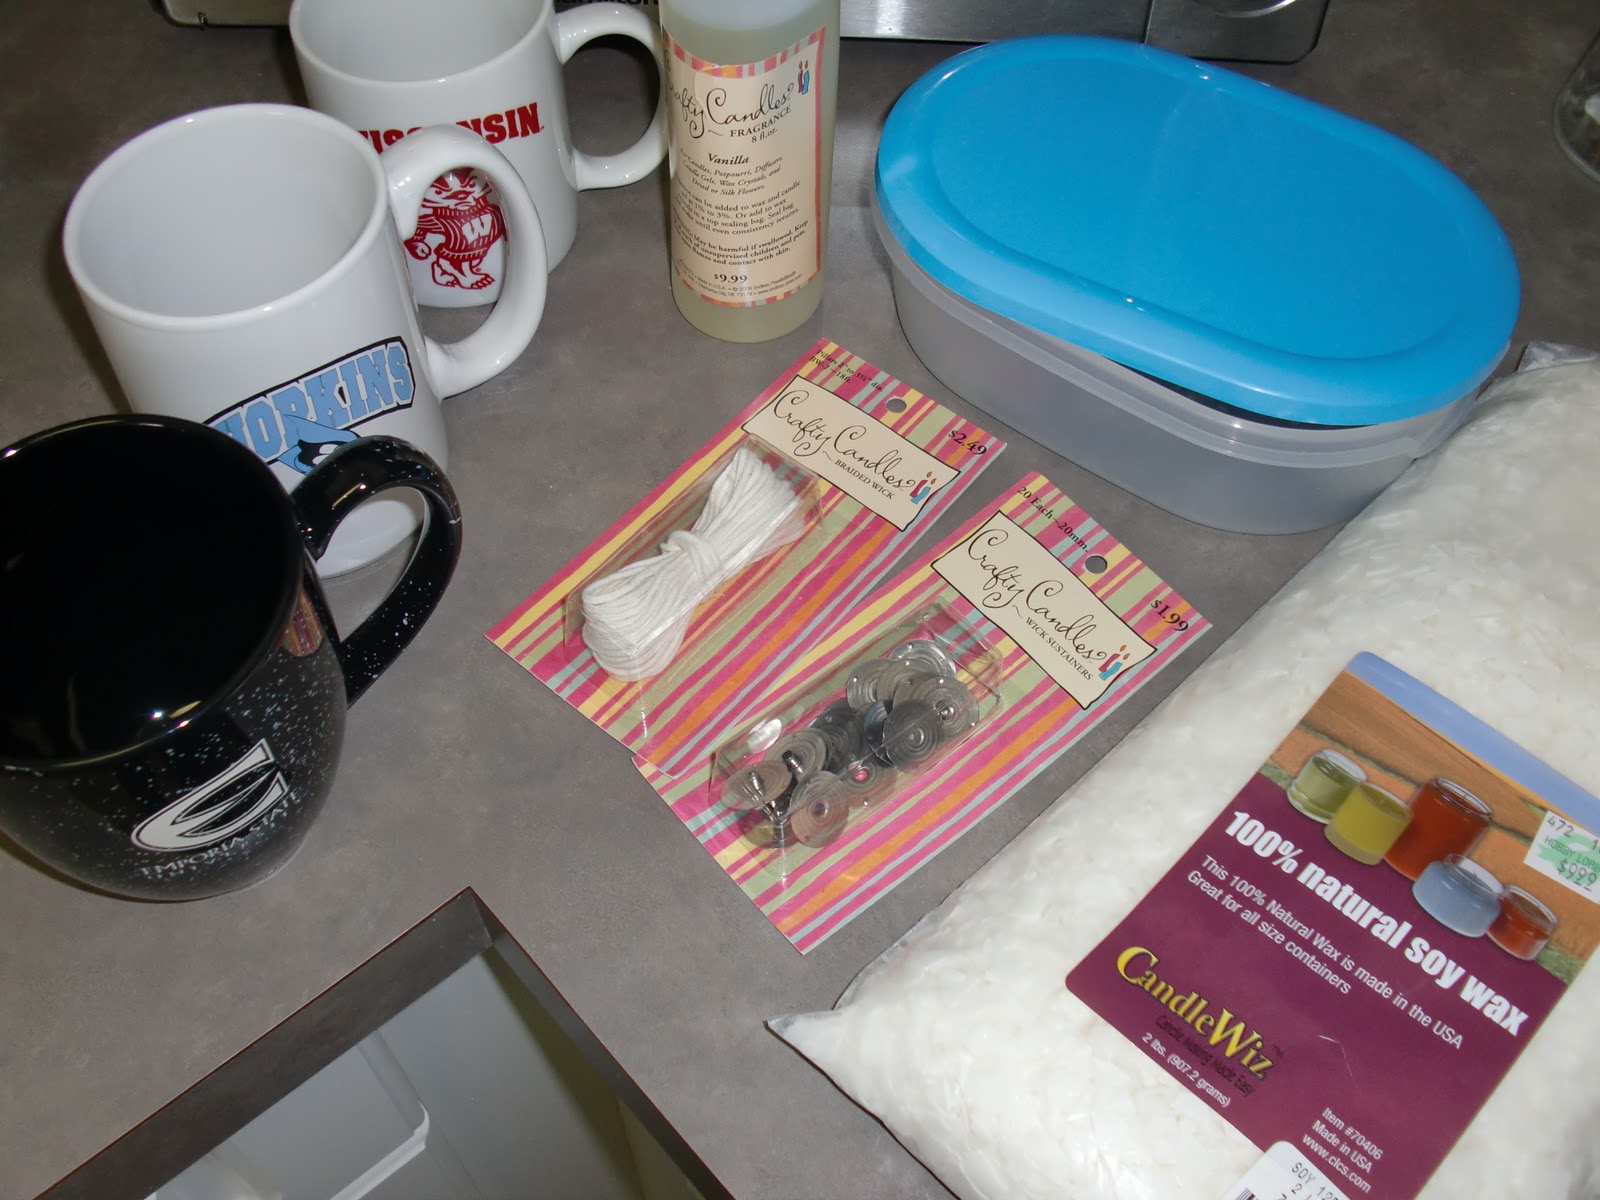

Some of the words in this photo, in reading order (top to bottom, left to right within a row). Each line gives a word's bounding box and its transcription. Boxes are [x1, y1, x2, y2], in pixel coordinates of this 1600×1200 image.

[730, 106, 792, 138] FRAGRANCE
[707, 152, 750, 166] Vanilla
[719, 179, 737, 187] Wax
[720, 188, 736, 196] Silk
[703, 199, 713, 209] be
[714, 203, 739, 212] added
[751, 199, 766, 209] wax
[767, 191, 780, 204] and
[735, 212, 748, 220] Or
[749, 207, 764, 218] add
[773, 198, 787, 208] wax
[461, 213, 492, 244] W
[706, 217, 719, 227] top
[720, 220, 749, 229] sealing
[767, 207, 782, 220] Seal
[782, 202, 795, 212] bag
[712, 227, 730, 235] even
[731, 220, 775, 236] consistency
[693, 233, 707, 247] May
[708, 242, 717, 250] be
[718, 244, 749, 253] harmful
[700, 246, 749, 259] unsupervised
[750, 245, 779, 258] children
[780, 236, 792, 247] and
[728, 258, 756, 266] contact
[757, 253, 774, 263] with
[713, 273, 748, 285] $9.99
[773, 389, 831, 457] Crafty
[833, 425, 916, 489] Candles
[949, 429, 988, 456] $2.49
[834, 458, 872, 485] BRAIDED
[871, 481, 896, 500] WICK
[1017, 486, 1031, 499] 20
[968, 528, 1025, 609] Crafty
[1026, 580, 1107, 661] Candles
[1151, 598, 1190, 633] $1.99
[1025, 616, 1049, 641] WICK
[1046, 636, 1094, 681] SUSTAINERS
[1547, 815, 1574, 838] 472
[1544, 835, 1576, 857] HOBBY
[1187, 869, 1223, 901] Great
[1221, 894, 1243, 913] for
[1240, 908, 1261, 926] all
[1257, 919, 1286, 945] size
[1284, 940, 1351, 994] containers
[1225, 811, 1303, 874] 100%
[1296, 862, 1413, 949] natural
[1404, 936, 1466, 989] soy
[1459, 974, 1529, 1037] wax
[1201, 854, 1229, 880] This
[1229, 875, 1267, 906] 100%
[1266, 899, 1315, 940] Natural
[1312, 933, 1342, 962] Wax
[1340, 954, 1355, 971] is
[1354, 967, 1393, 999] made
[1392, 992, 1408, 1010] in
[1408, 1003, 1432, 1027] the
[1432, 1020, 1464, 1050] USA
[1116, 946, 1274, 1080] CandleWiz
[1141, 1032, 1153, 1043] 2
[1150, 1038, 1167, 1058] lbs.
[1167, 1053, 1200, 1082] (907.2
[1196, 1077, 1231, 1108] grams)
[1312, 1119, 1341, 1147] Made
[1339, 1142, 1351, 1156] in
[1350, 1151, 1374, 1175] USA
[1321, 1107, 1345, 1131] Item
[1344, 1126, 1385, 1161] #70406
[1291, 1162, 1316, 1184] SOY
[1302, 1134, 1372, 1194] www.clcs.com
[1291, 1183, 1303, 1195] 2
